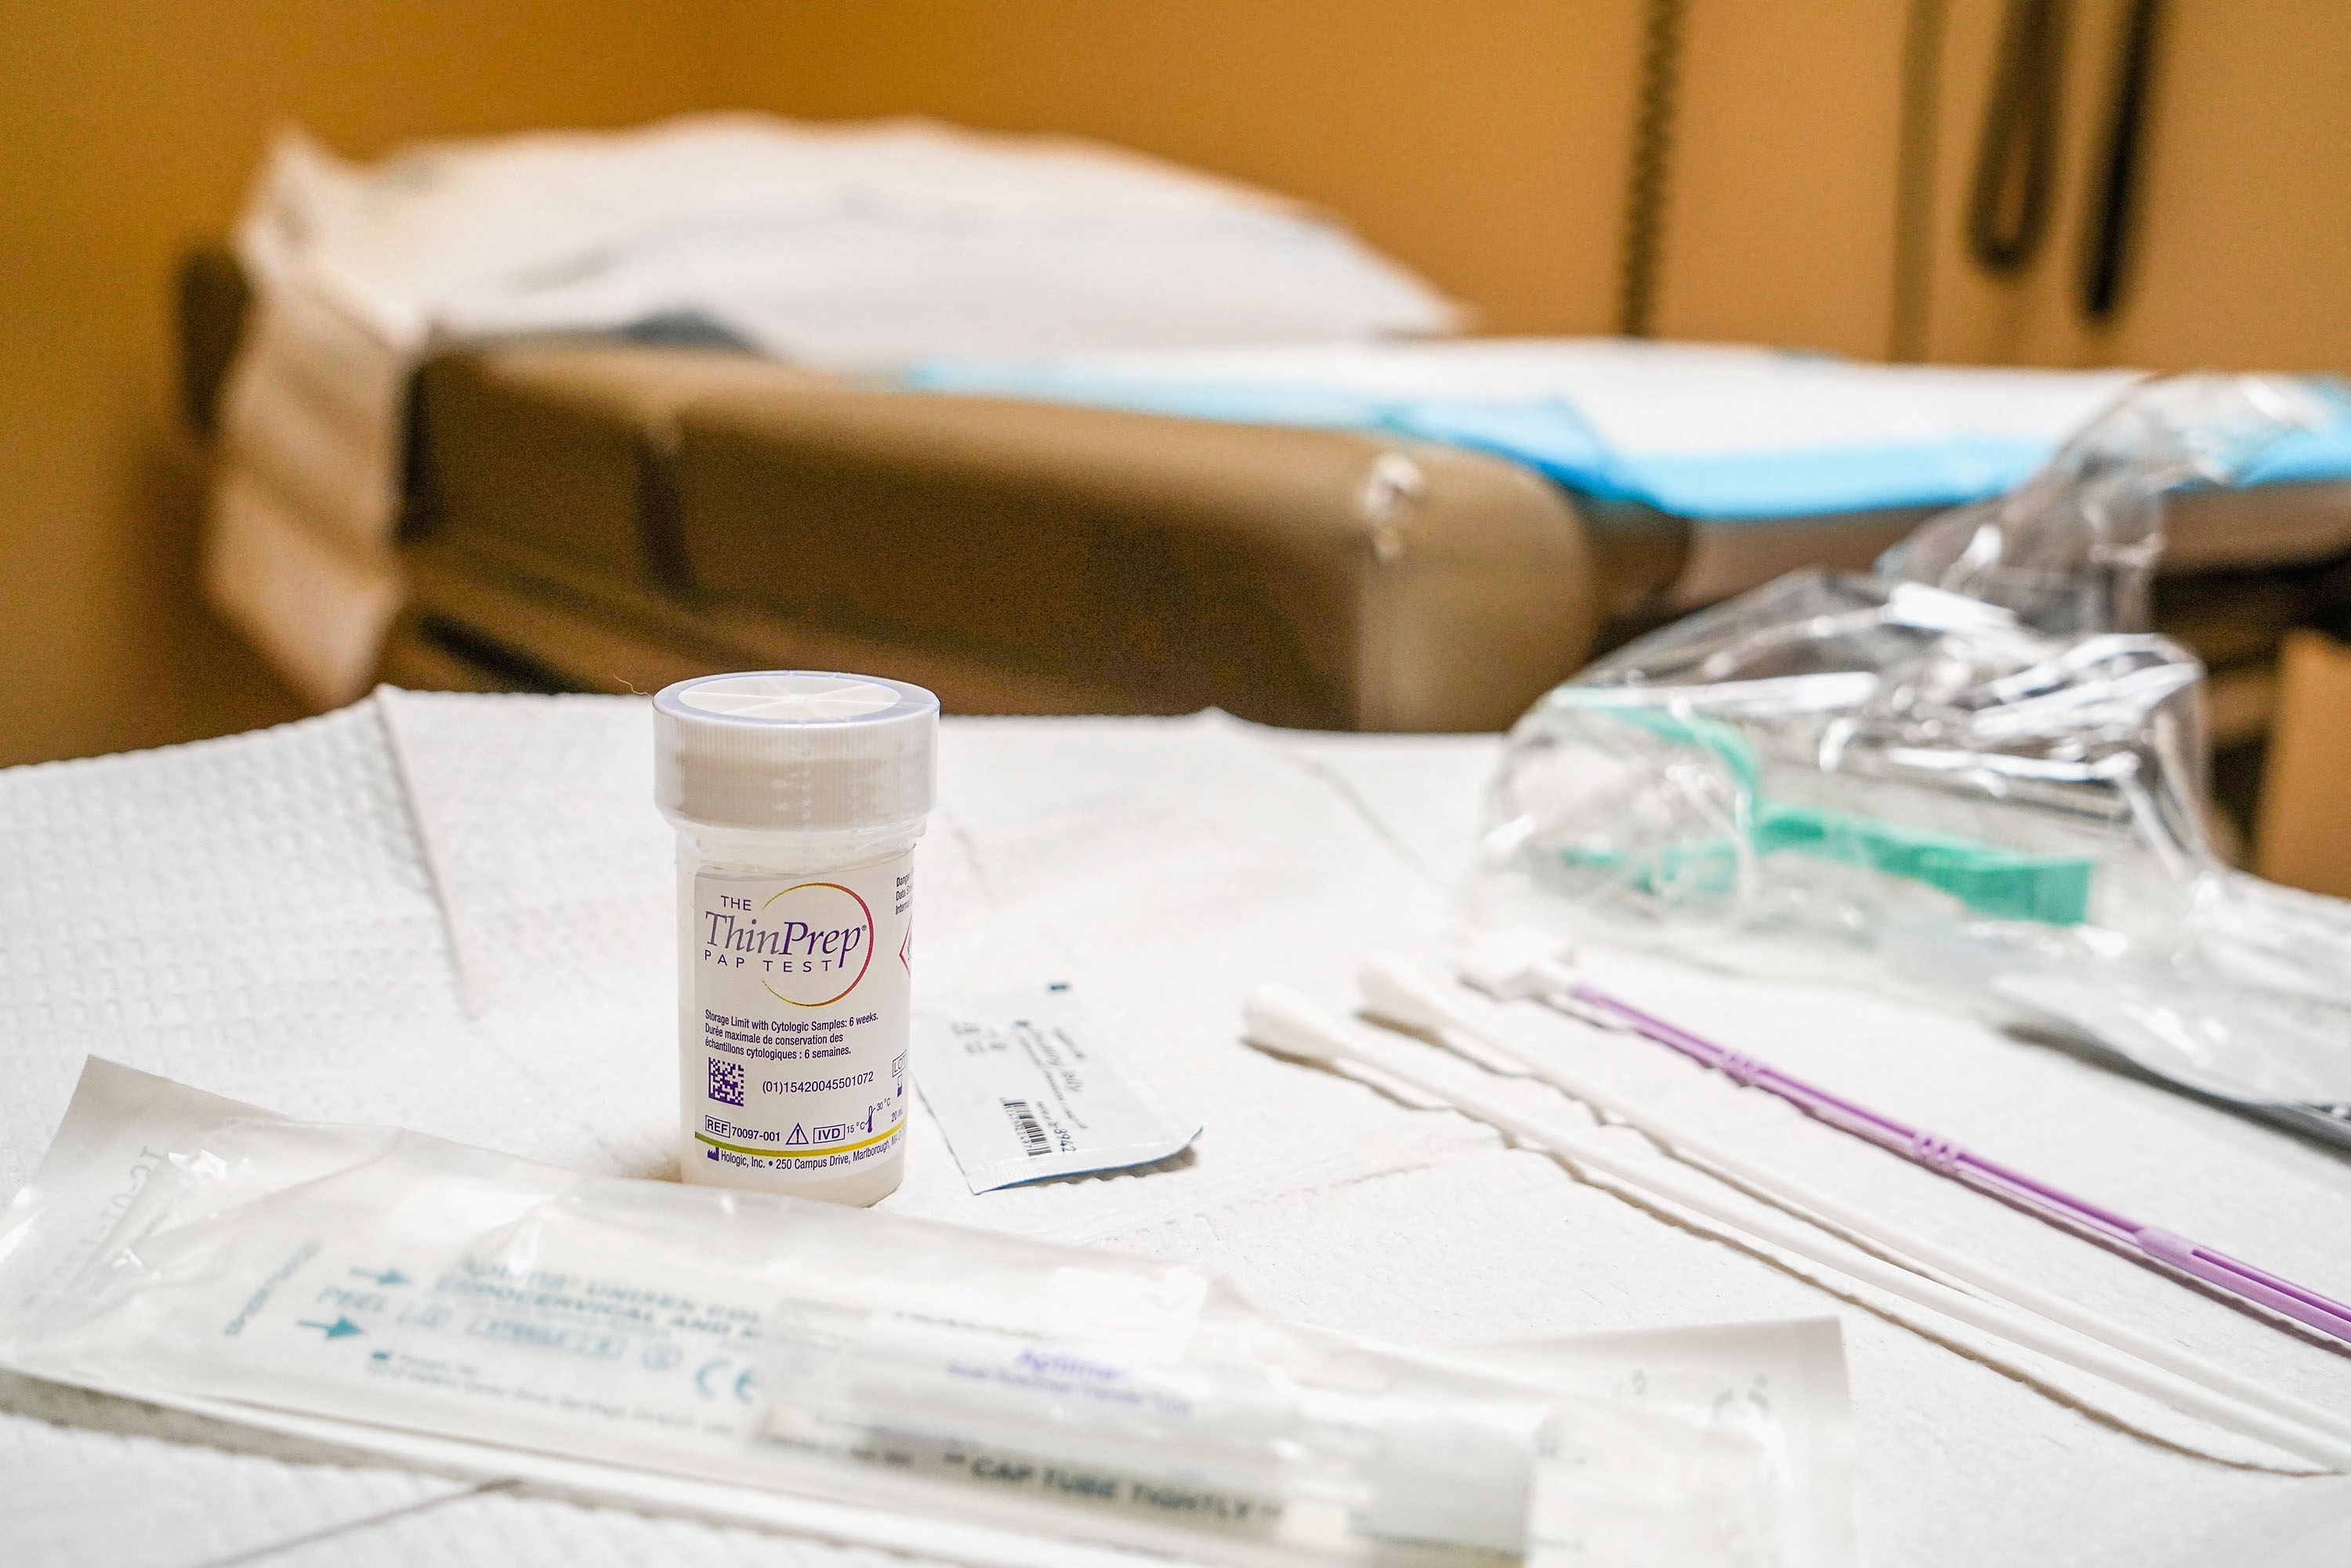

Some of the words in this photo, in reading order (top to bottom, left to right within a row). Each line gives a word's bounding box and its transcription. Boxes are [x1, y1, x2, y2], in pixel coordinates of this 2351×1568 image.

[720, 895, 752, 911] THE
[705, 949, 745, 969] PAP
[763, 960, 832, 973] TEST
[705, 1009, 730, 1027] Storage
[730, 1016, 750, 1030] Limit
[752, 1019, 769, 1031] with
[771, 1021, 810, 1034] Cytologic
[811, 1019, 848, 1033] Samples:
[849, 1016, 854, 1027] 6
[855, 1012, 879, 1027] weeks.
[705, 1022, 723, 1037] Durée
[724, 1027, 759, 1044] maximale
[762, 1034, 773, 1045] de
[775, 1034, 828, 1046] conservation
[829, 1033, 844, 1044] des
[705, 1038, 745, 1056] échantillons
[746, 1046, 798, 1060] cytologiques
[804, 1048, 810, 1059] 6
[812, 1045, 852, 1059] semaines.
[876, 1102, 883, 1111] 30
[891, 1110, 898, 1123] 20
[706, 1118, 729, 1135] REF
[731, 1126, 781, 1142] 70097-001
[817, 1127, 842, 1141] IVD
[846, 1124, 855, 1133] 15
[721, 1150, 750, 1168] Hologic,
[751, 1157, 766, 1169] Inc.
[776, 1159, 792, 1170] 250
[795, 1156, 828, 1171] Campus
[829, 1152, 852, 1168] Drive,
[852, 1139, 892, 1161] Marlborough,
